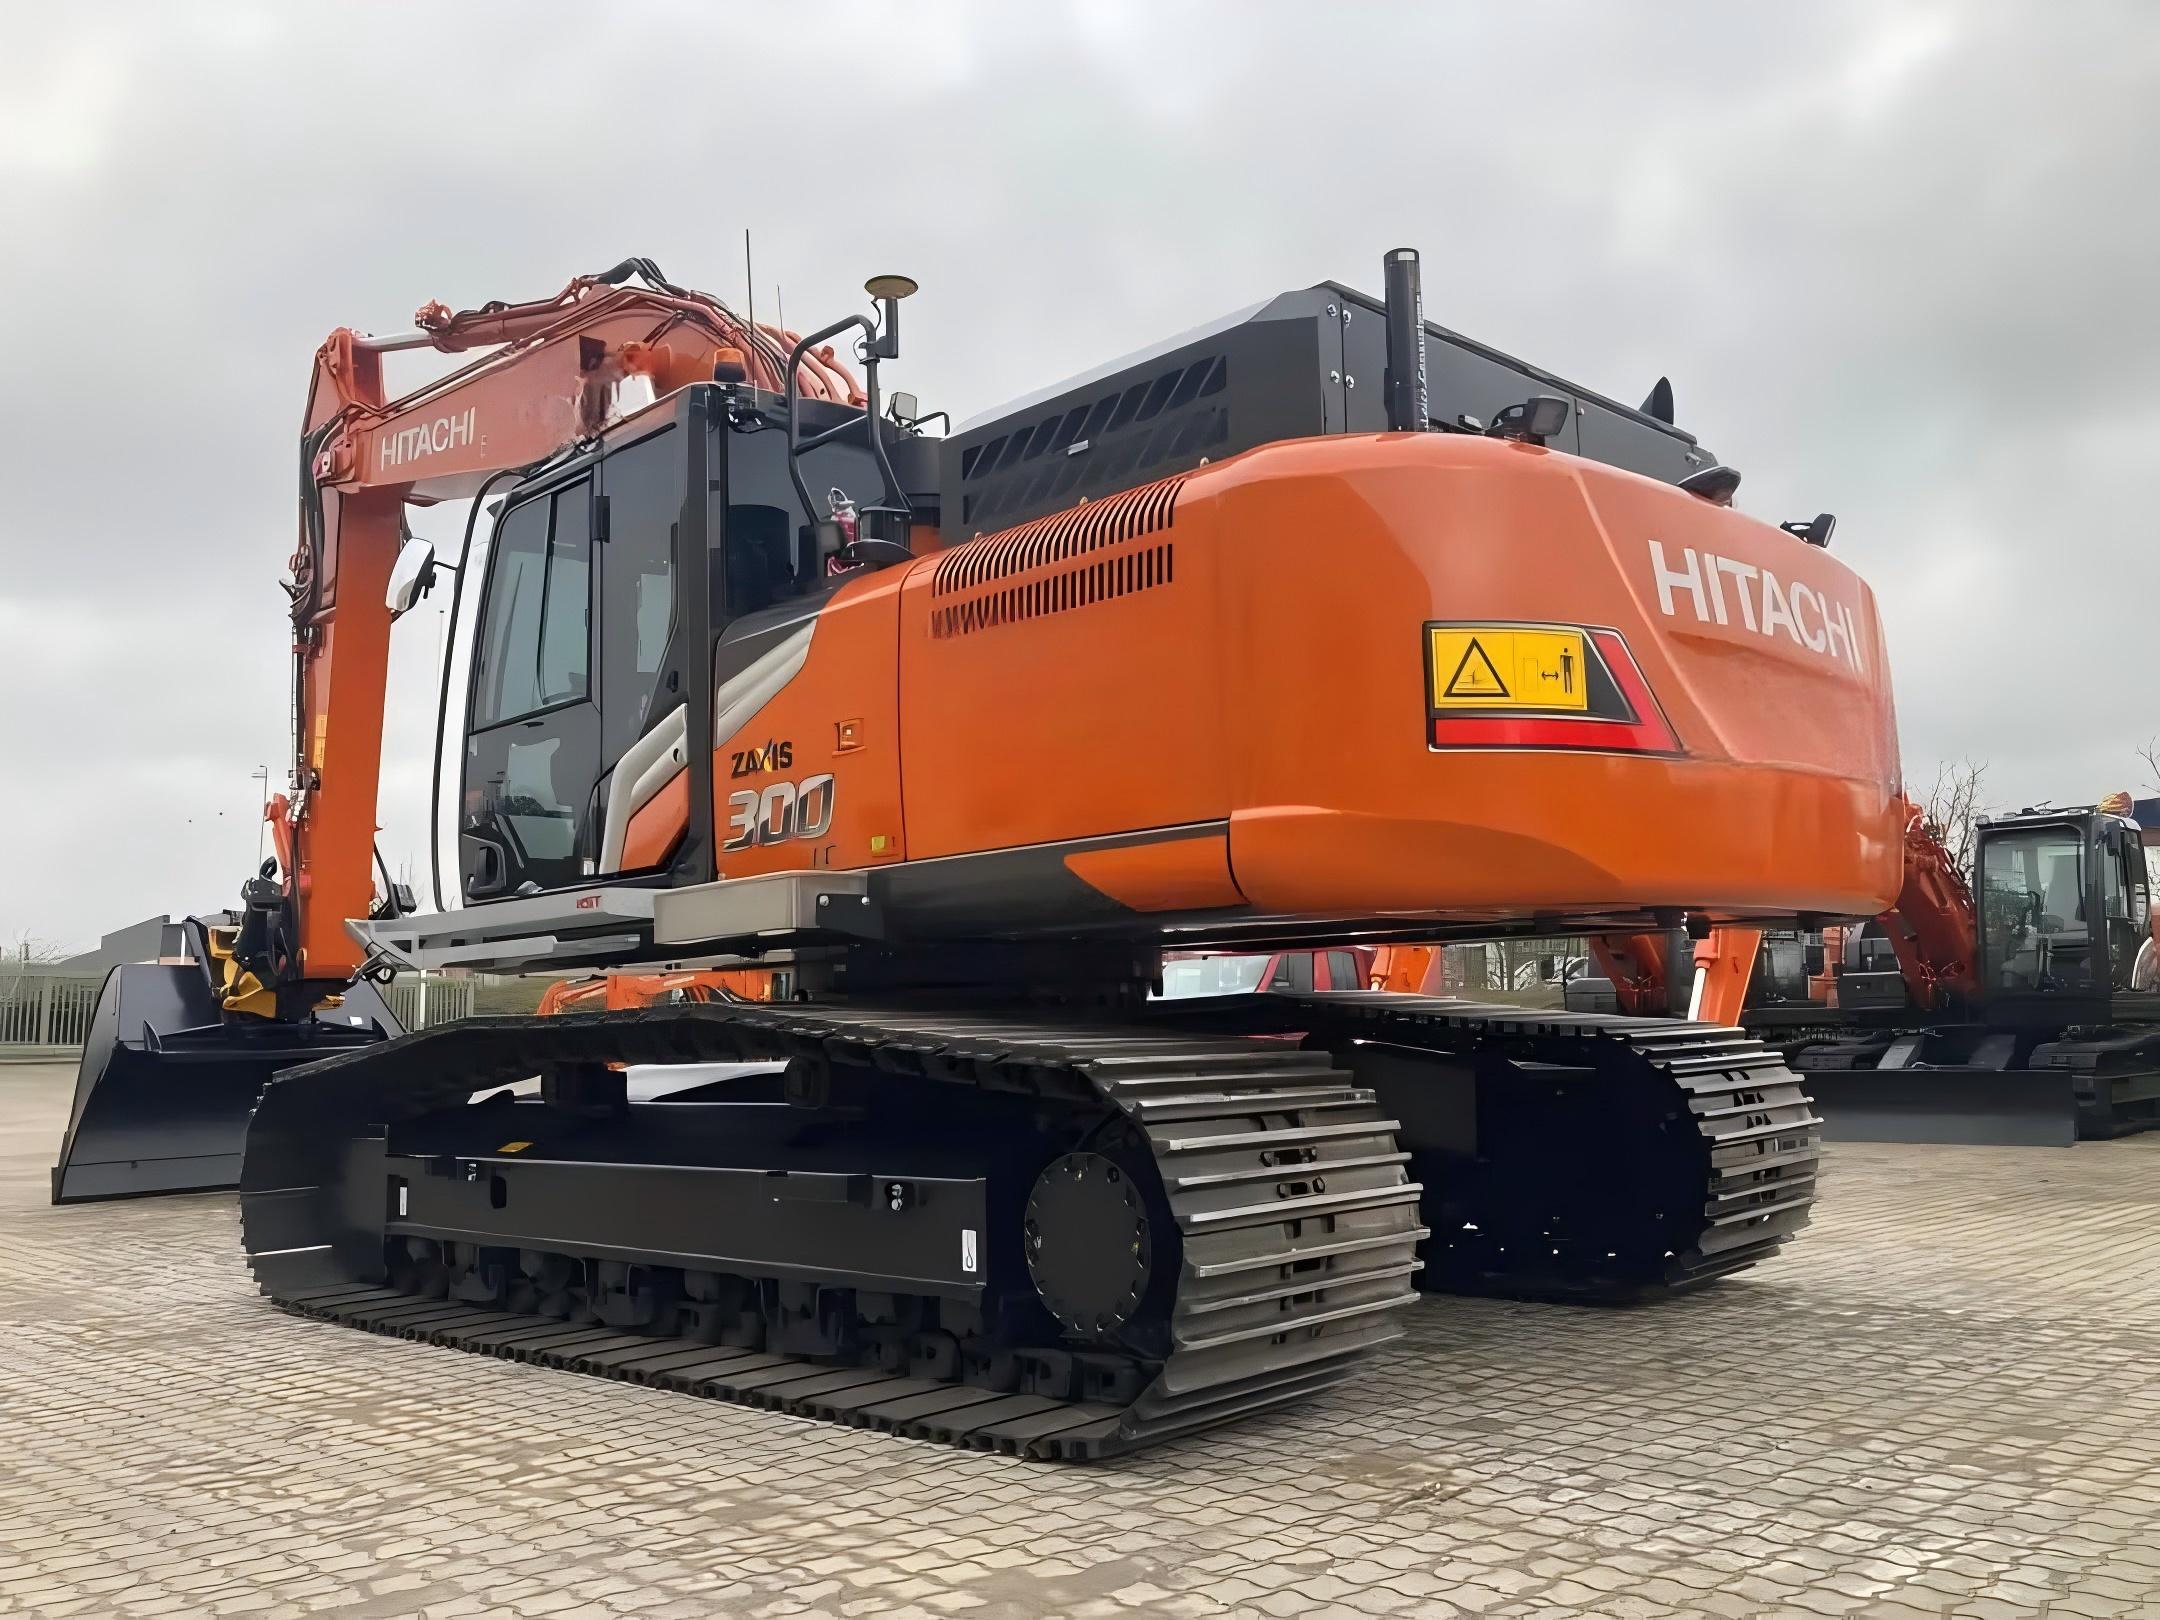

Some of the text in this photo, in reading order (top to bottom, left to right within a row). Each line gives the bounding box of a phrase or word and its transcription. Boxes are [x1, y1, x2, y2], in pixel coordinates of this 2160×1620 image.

[381, 406, 476, 472] HITACHI
[1648, 540, 1864, 674] HITACHI
[731, 740, 793, 779] ZAXIS
[722, 772, 834, 853] 300
